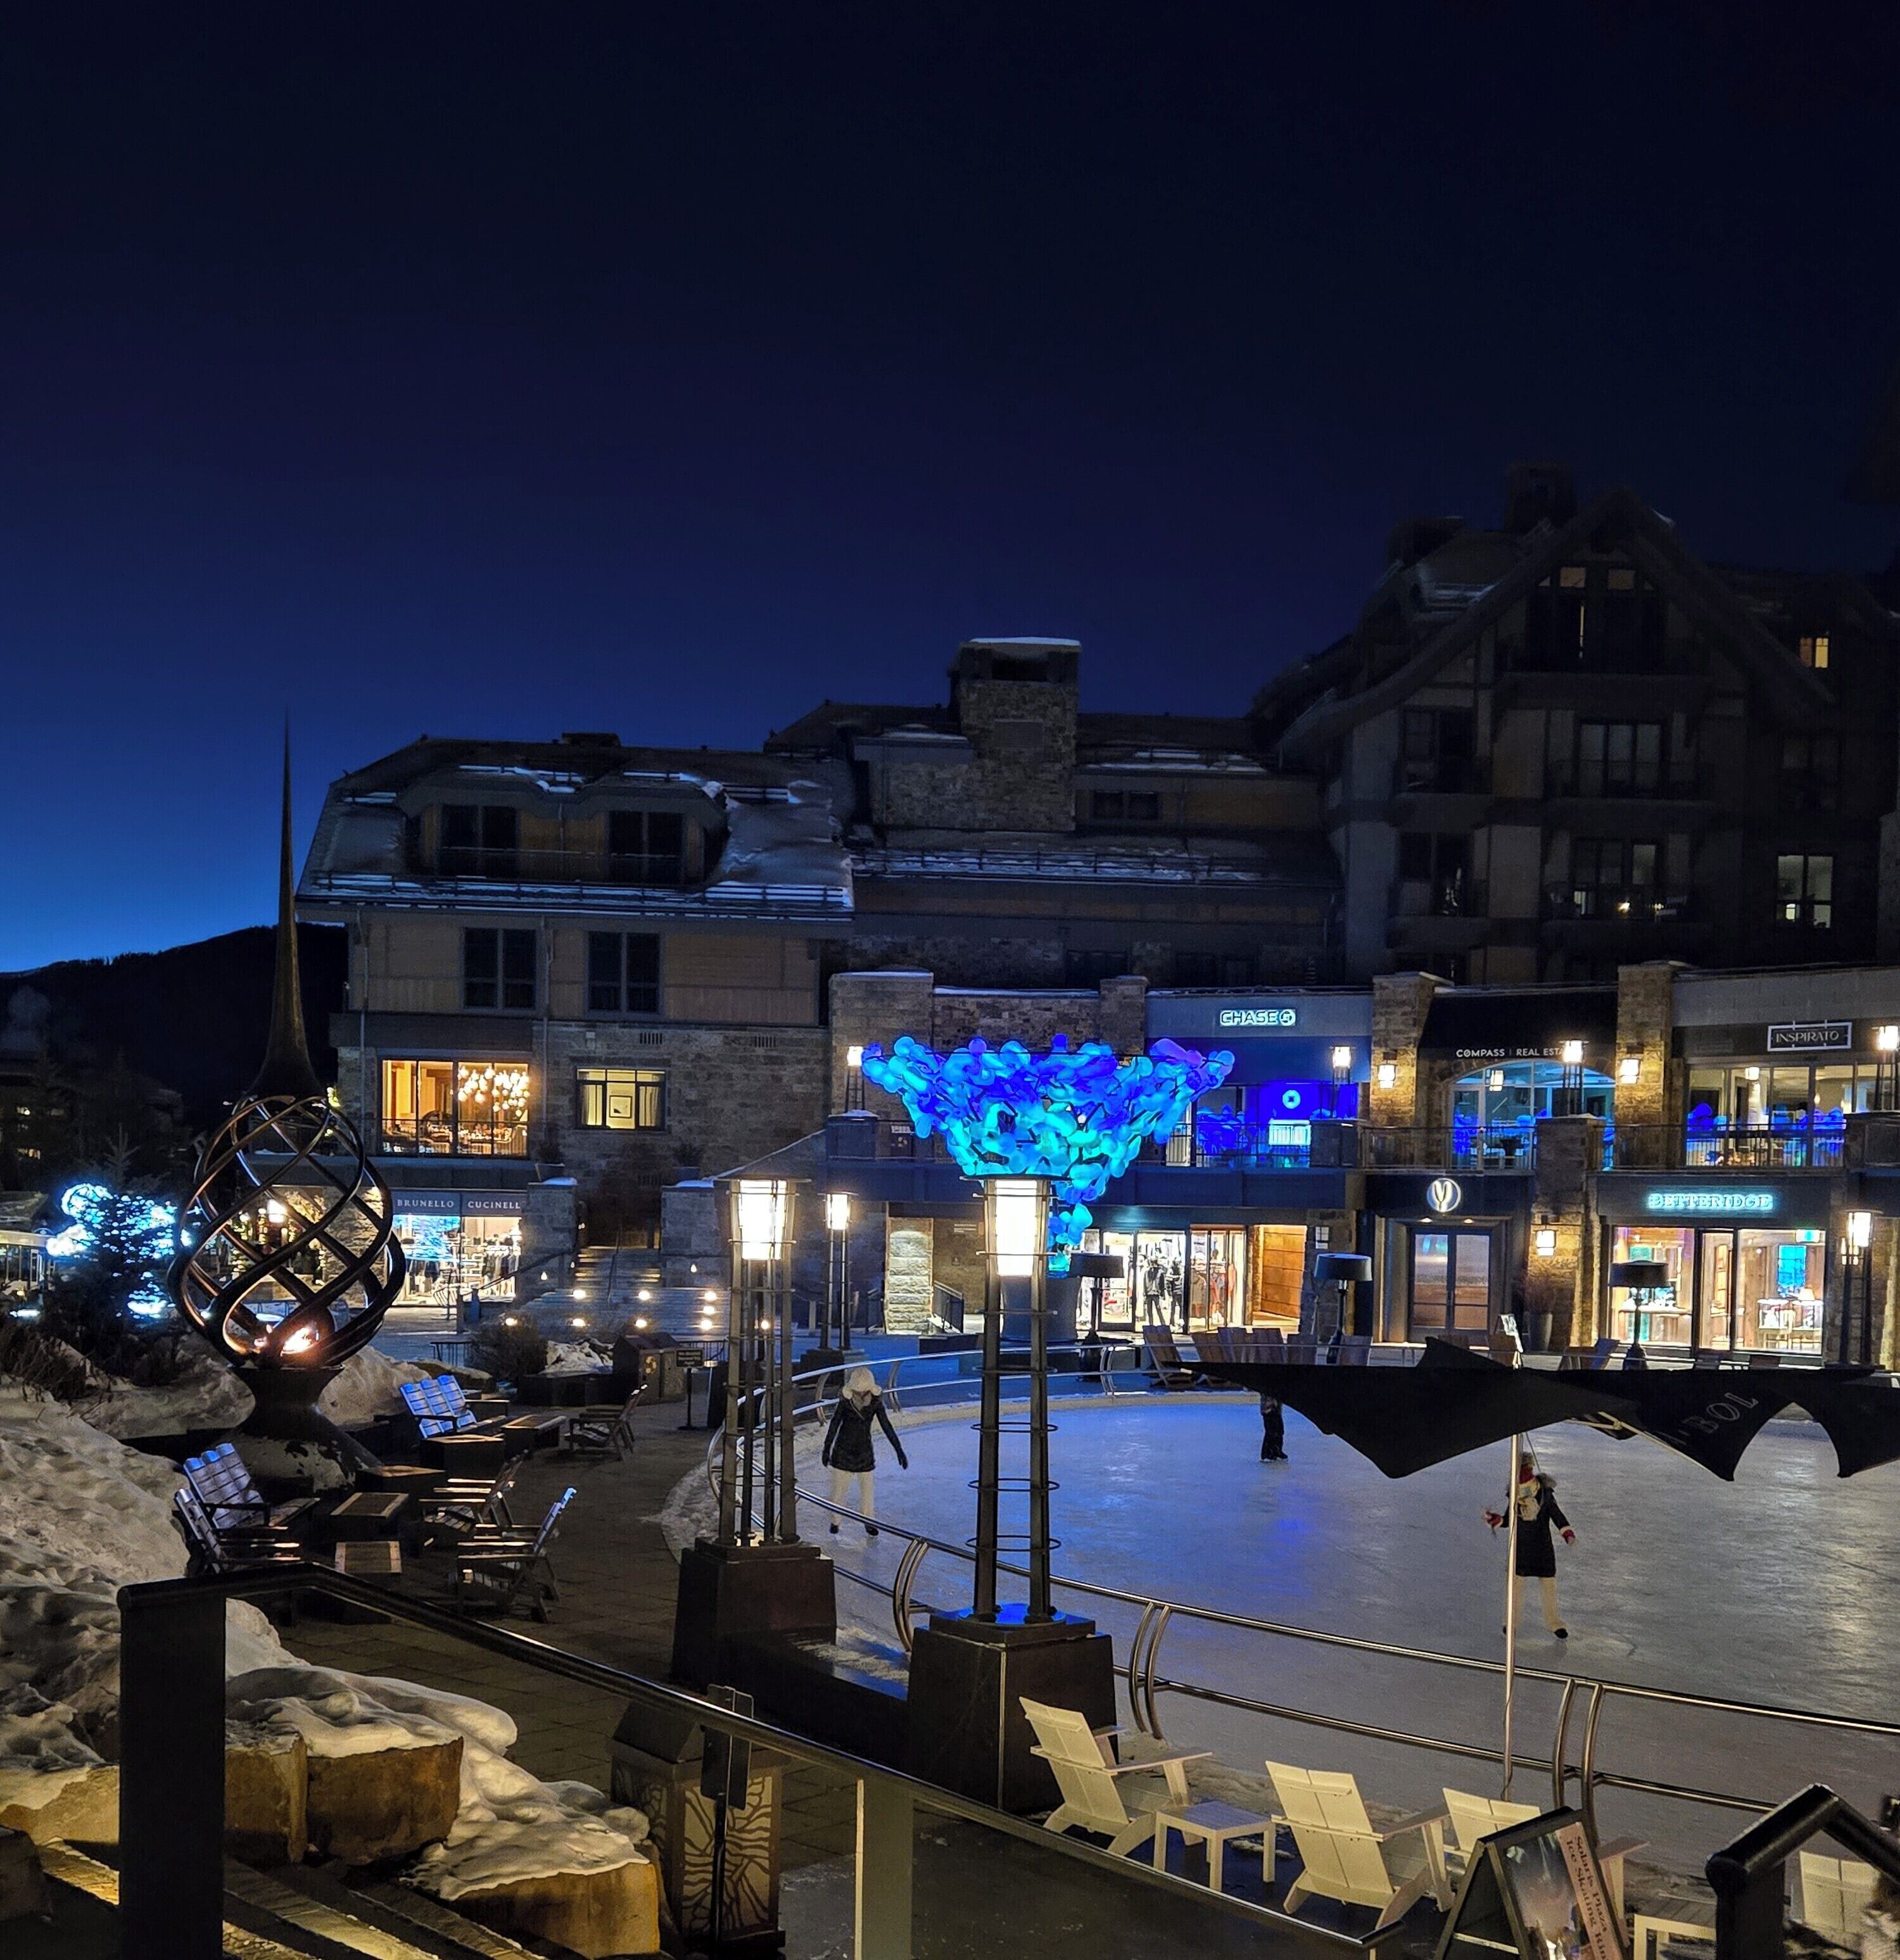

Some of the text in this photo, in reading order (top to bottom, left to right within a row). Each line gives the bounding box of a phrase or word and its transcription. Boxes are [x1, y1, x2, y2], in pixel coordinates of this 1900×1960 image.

[1220, 1011, 1278, 1025] CHASE
[1776, 1030, 1839, 1043] INSPIRATO
[1456, 1047, 1566, 1058] COMPASS REAL ESTA
[396, 1199, 521, 1210] BRUNELLO CUCINELL
[1649, 1194, 1772, 1209] BETTERIDGE
[1566, 1839, 1610, 1960] Ice Skating Rin
[1592, 1892, 1607, 1932] Plaza
